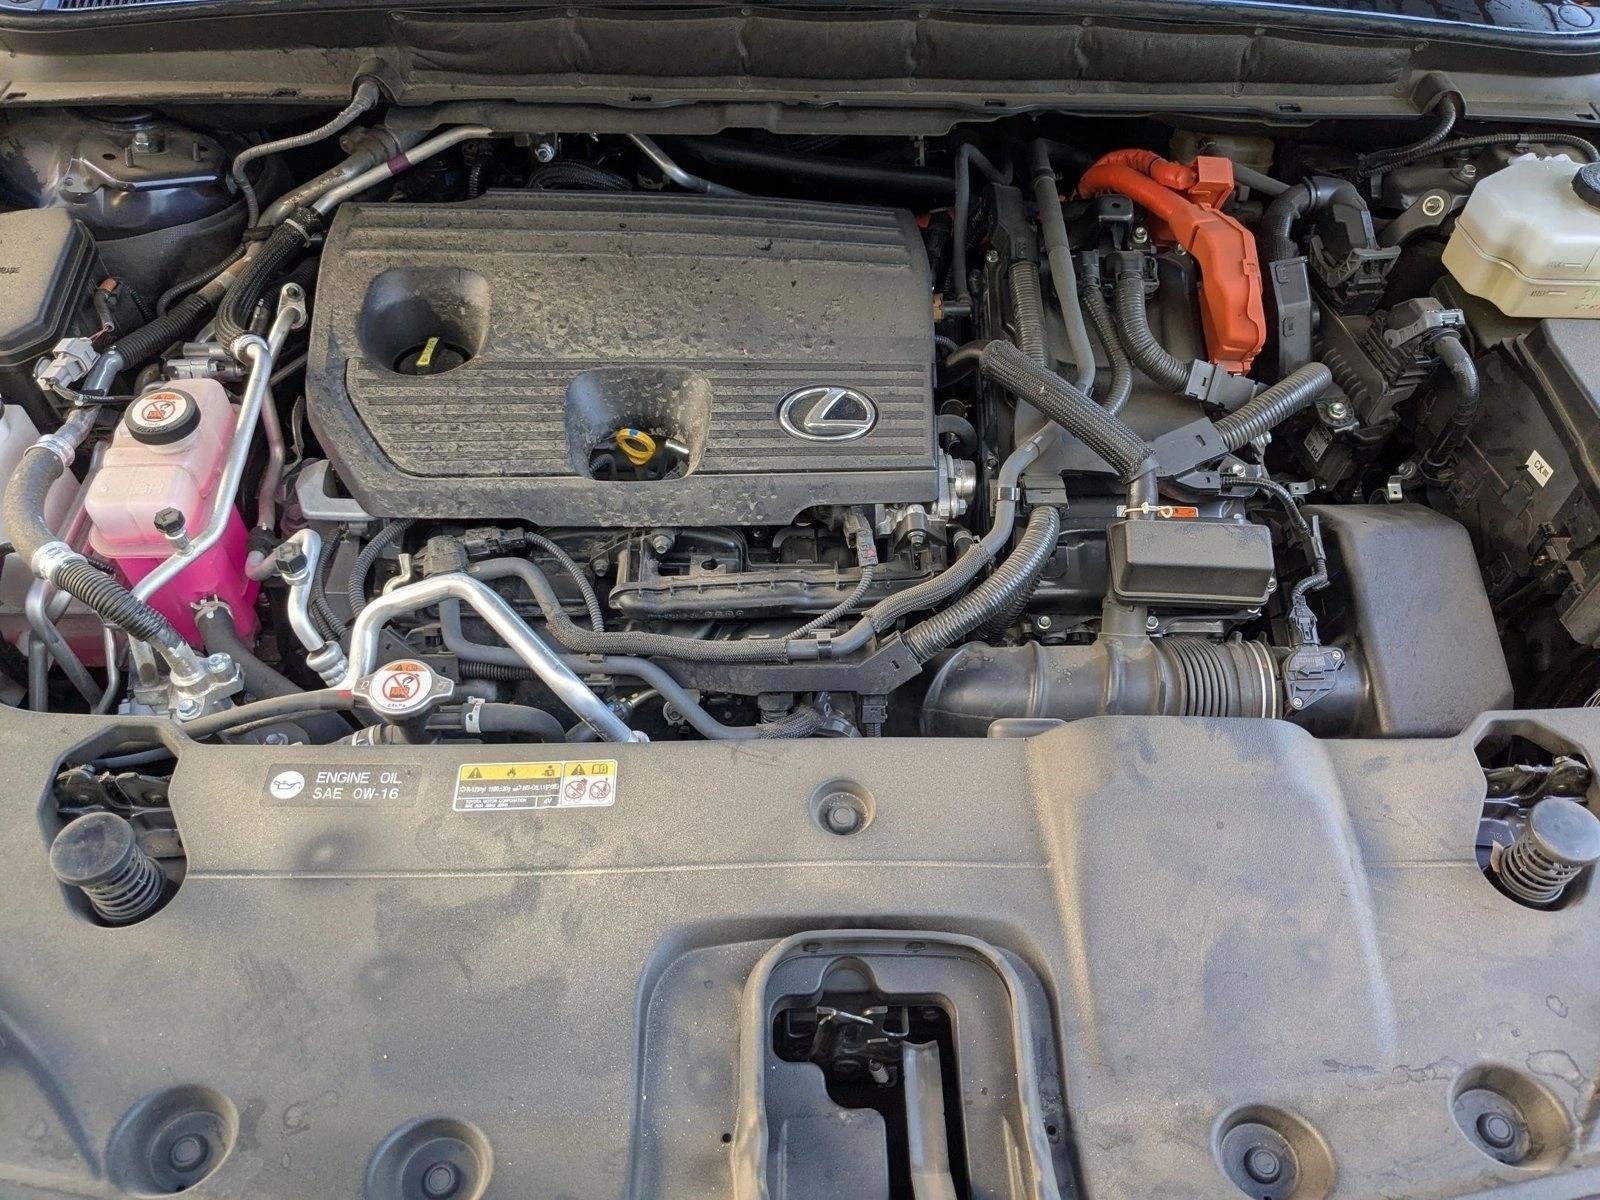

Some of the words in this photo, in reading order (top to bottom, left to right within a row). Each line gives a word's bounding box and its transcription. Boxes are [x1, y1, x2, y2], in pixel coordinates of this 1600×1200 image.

[316, 772, 371, 784] ENGINE
[380, 772, 402, 784] OIL
[312, 787, 344, 800] SAE
[353, 787, 400, 800] 0W-16
